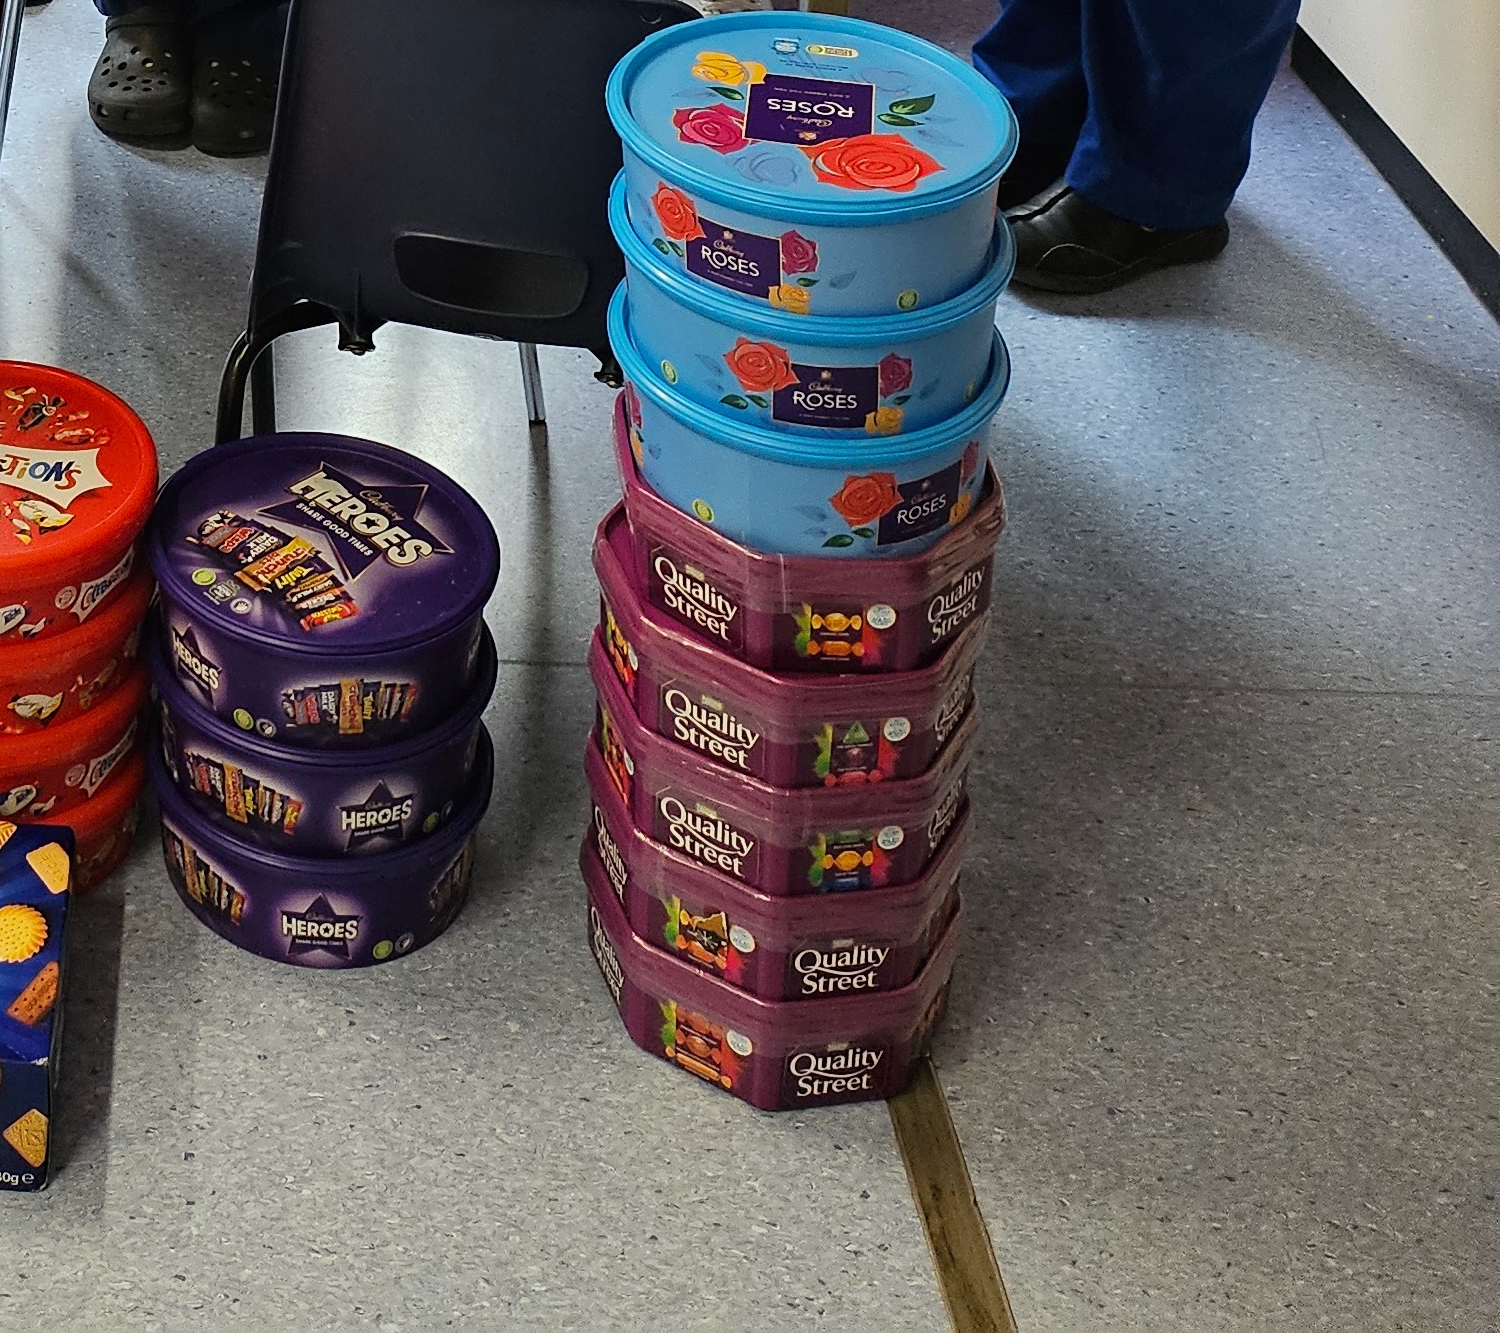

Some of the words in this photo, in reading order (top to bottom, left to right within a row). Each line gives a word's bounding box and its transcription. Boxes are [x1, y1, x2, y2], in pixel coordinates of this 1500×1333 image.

[767, 98, 855, 118] ROSES
[700, 245, 760, 278] ROSES
[792, 390, 857, 411] ROSES
[287, 473, 436, 567] HEROES
[296, 503, 323, 523] SHARE
[322, 517, 350, 539] GOOD
[348, 536, 374, 557] TIMES
[896, 492, 946, 526] ROSES
[654, 555, 737, 621] Quality
[928, 566, 986, 624] Quality
[663, 585, 730, 642] Street
[931, 594, 978, 643] Street
[173, 634, 219, 690] HEROES
[665, 688, 760, 750] Quality
[673, 718, 750, 770] Street
[341, 799, 413, 831] HEROES
[661, 795, 754, 858] Quality
[669, 826, 746, 879] Street
[282, 915, 358, 941] HEROES
[795, 944, 890, 977] Quality
[801, 967, 878, 995] Street
[790, 1047, 883, 1080] Quality
[796, 1069, 870, 1098] Street
